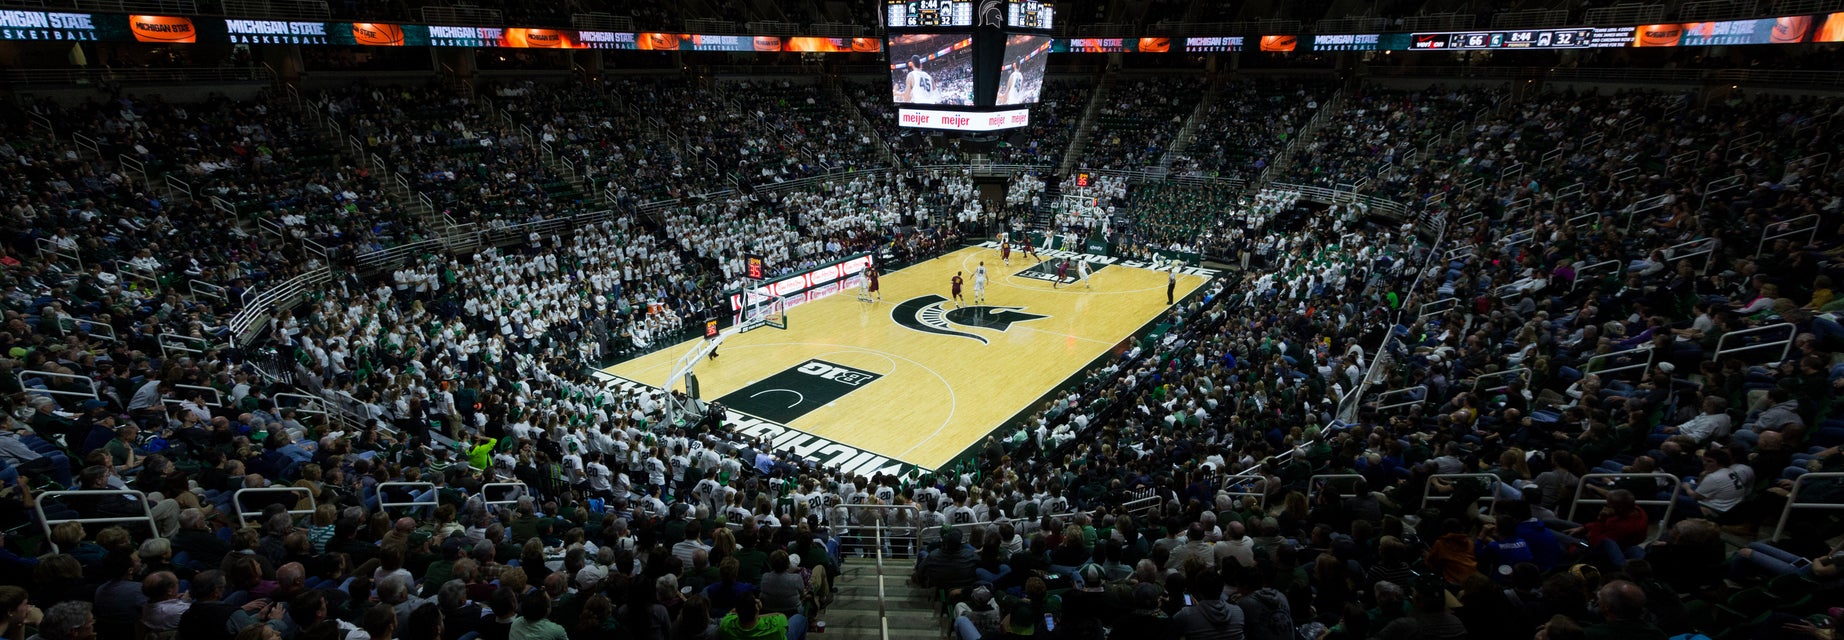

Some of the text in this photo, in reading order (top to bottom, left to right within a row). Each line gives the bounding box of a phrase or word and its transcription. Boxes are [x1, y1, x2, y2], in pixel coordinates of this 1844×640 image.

[0, 10, 95, 29] HIGAN STATE
[941, 17, 951, 25] 32
[225, 19, 326, 35] MICHIGAN STATE
[428, 26, 503, 39] MICHIGAN STATE
[230, 35, 327, 44] BASKETBALL
[579, 31, 635, 43] MICHIGAN STATE
[1186, 37, 1244, 46] MICHIGAN STATE
[1314, 34, 1379, 44] MICHIGAN STATE
[1469, 36, 1483, 46] 66
[1511, 32, 1531, 41] 8:44
[1557, 34, 1572, 44] 32
[919, 76, 931, 92] 45
[903, 112, 930, 125] meijer
[941, 114, 970, 127] meijer
[989, 114, 1005, 127] meijer
[1011, 112, 1027, 123] meijer
[750, 265, 761, 278] 35
[564, 459, 573, 469] 20
[671, 459, 681, 468] 20
[588, 467, 598, 477] 20
[702, 483, 713, 494] 20
[880, 491, 891, 500] 20
[918, 493, 932, 503] 20
[644, 500, 655, 512] 20
[809, 496, 821, 509] 20
[1052, 501, 1066, 513] 20
[728, 511, 743, 524] 20
[955, 512, 969, 524] 20
